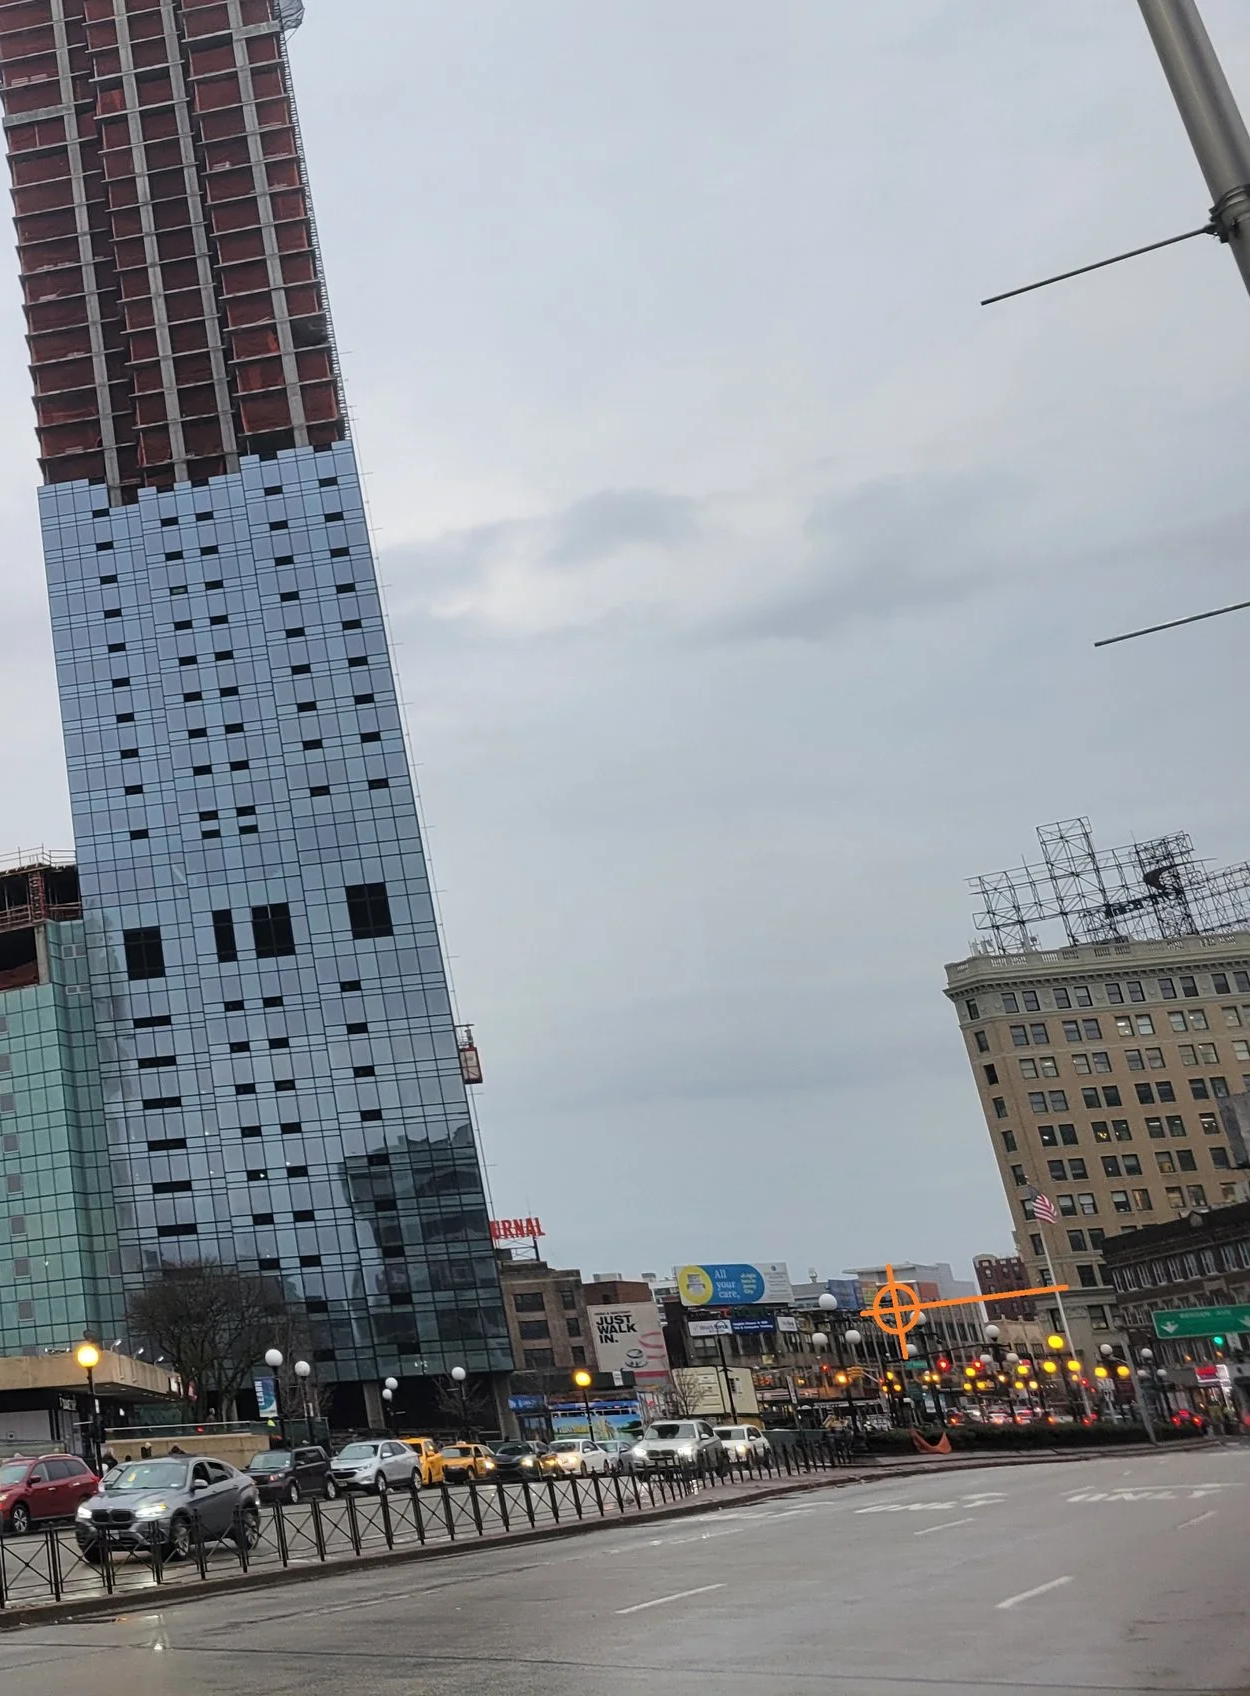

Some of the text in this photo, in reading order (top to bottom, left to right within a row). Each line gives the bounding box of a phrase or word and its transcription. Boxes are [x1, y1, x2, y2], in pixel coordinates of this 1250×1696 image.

[714, 1269, 727, 1279] All
[715, 1281, 736, 1292] your
[596, 1314, 632, 1326] JUST
[597, 1323, 638, 1335] WALK
[599, 1334, 619, 1344] IN.
